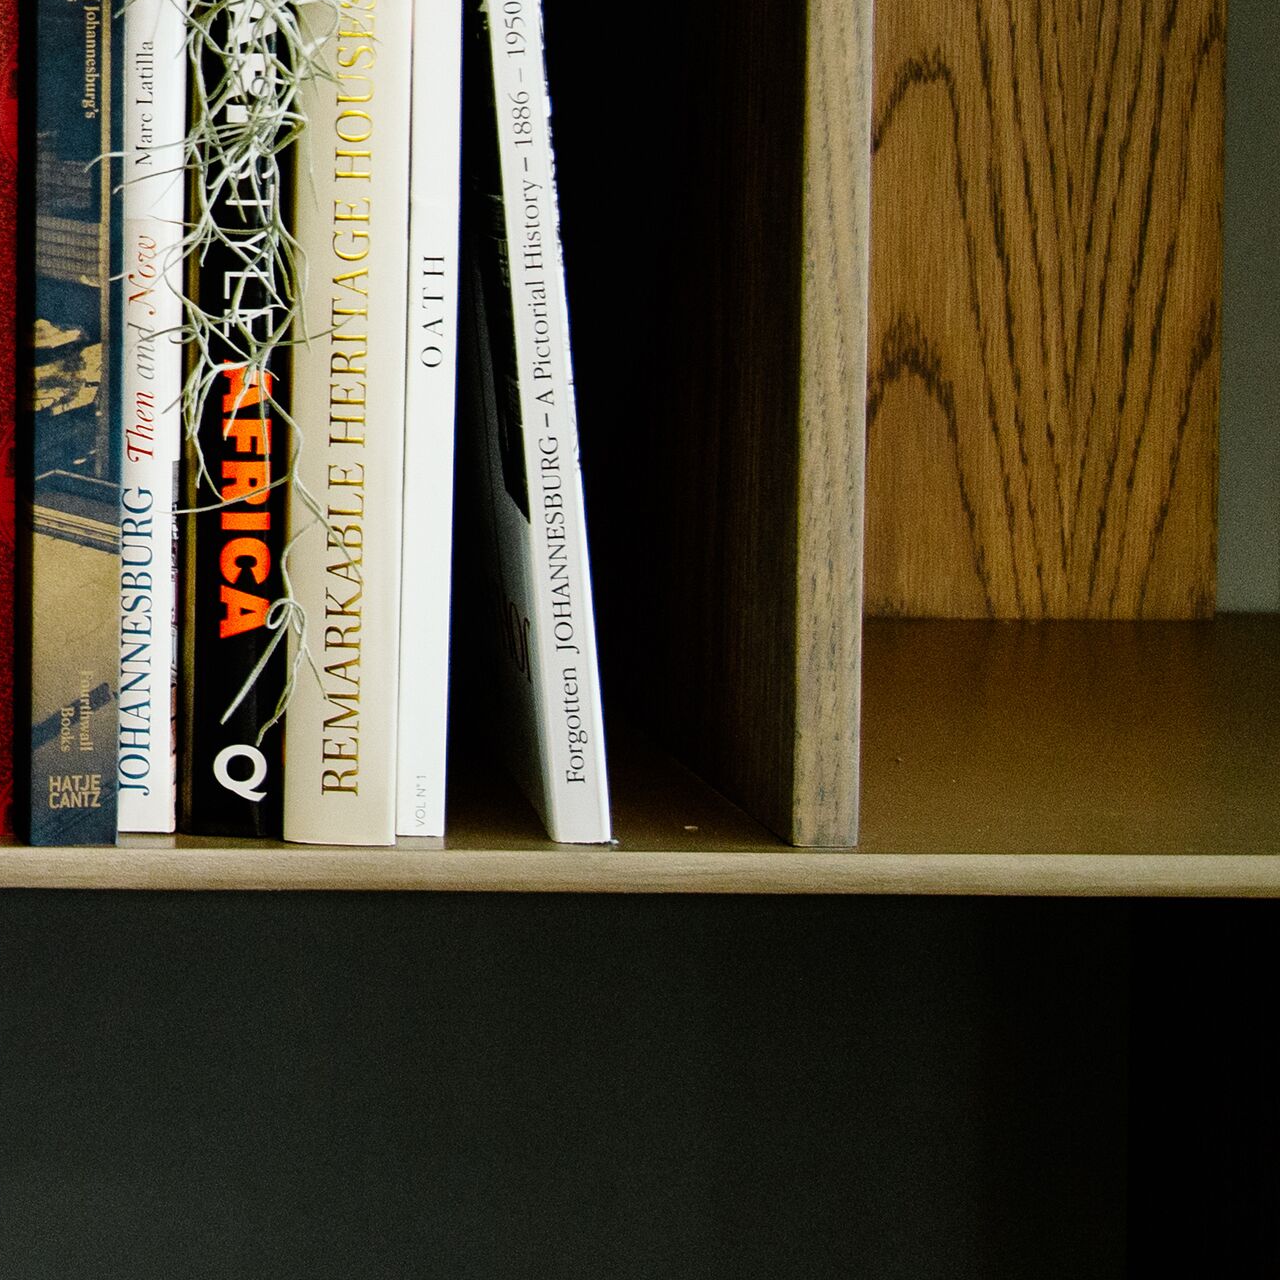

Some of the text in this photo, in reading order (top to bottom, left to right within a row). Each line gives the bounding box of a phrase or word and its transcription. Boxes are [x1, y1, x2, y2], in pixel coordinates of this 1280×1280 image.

[501, 0, 525, 60] 1950
[134, 39, 154, 166] Marc Latilla
[511, 90, 534, 148] 1886
[523, 178, 543, 271] History
[328, 196, 371, 449] HERITAGE
[419, 256, 445, 368] OATH
[525, 280, 553, 383] Pictorial
[535, 388, 555, 406] A
[117, 235, 157, 796] JOHANNESBURG Then and Now
[218, 358, 274, 639] AFRICA
[539, 434, 581, 655] JOHANNESBURG
[321, 460, 365, 797] REMARKABLE
[60, 707, 75, 753] Books
[79, 670, 95, 752] Fourthwall
[565, 665, 590, 784] Forgotten
[49, 774, 101, 792] HATJE
[49, 792, 101, 809] CANTZ
[414, 802, 427, 827] VOL
